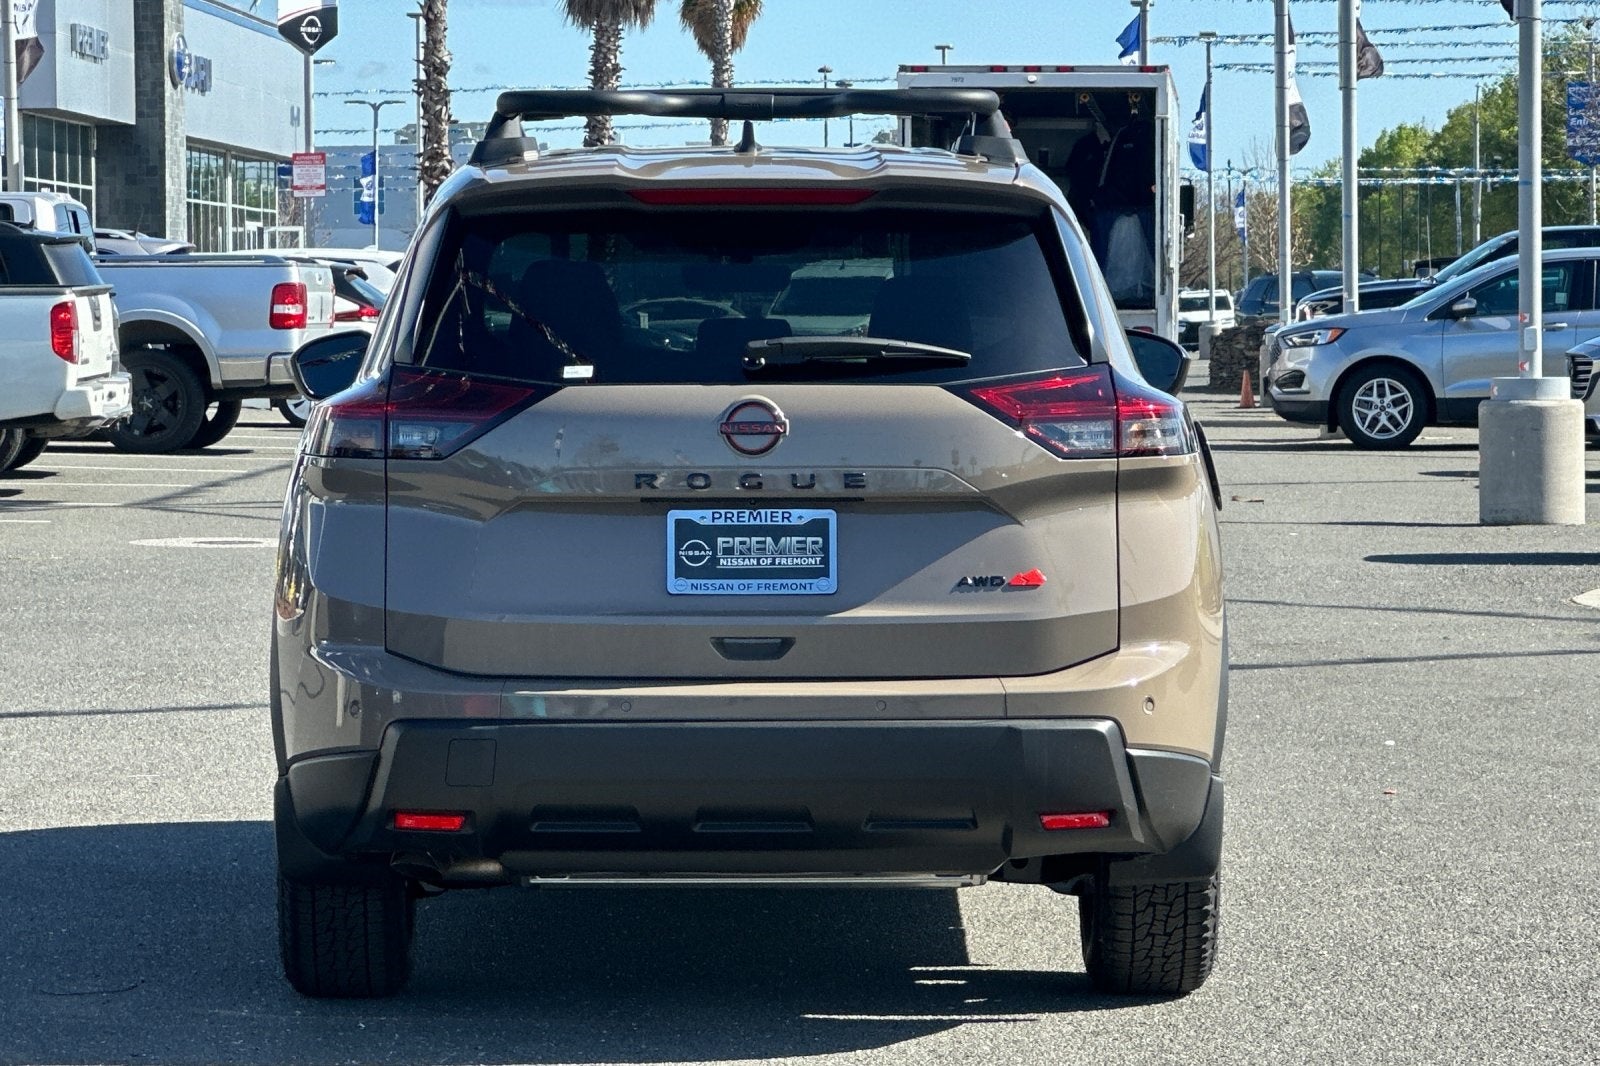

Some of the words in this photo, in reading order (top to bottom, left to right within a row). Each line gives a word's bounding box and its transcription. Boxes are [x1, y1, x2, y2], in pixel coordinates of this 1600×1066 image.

[721, 424, 785, 433] NISSAN
[634, 472, 866, 489] ROGUE
[711, 511, 792, 523] PREMIER
[717, 536, 824, 555] PREMIER
[720, 558, 753, 566] NISSAN
[775, 557, 822, 565] FREMONT
[690, 582, 734, 591] NISSAN
[737, 582, 754, 591] OF
[757, 582, 814, 591] FREMONT
[957, 575, 1006, 587] AWD
